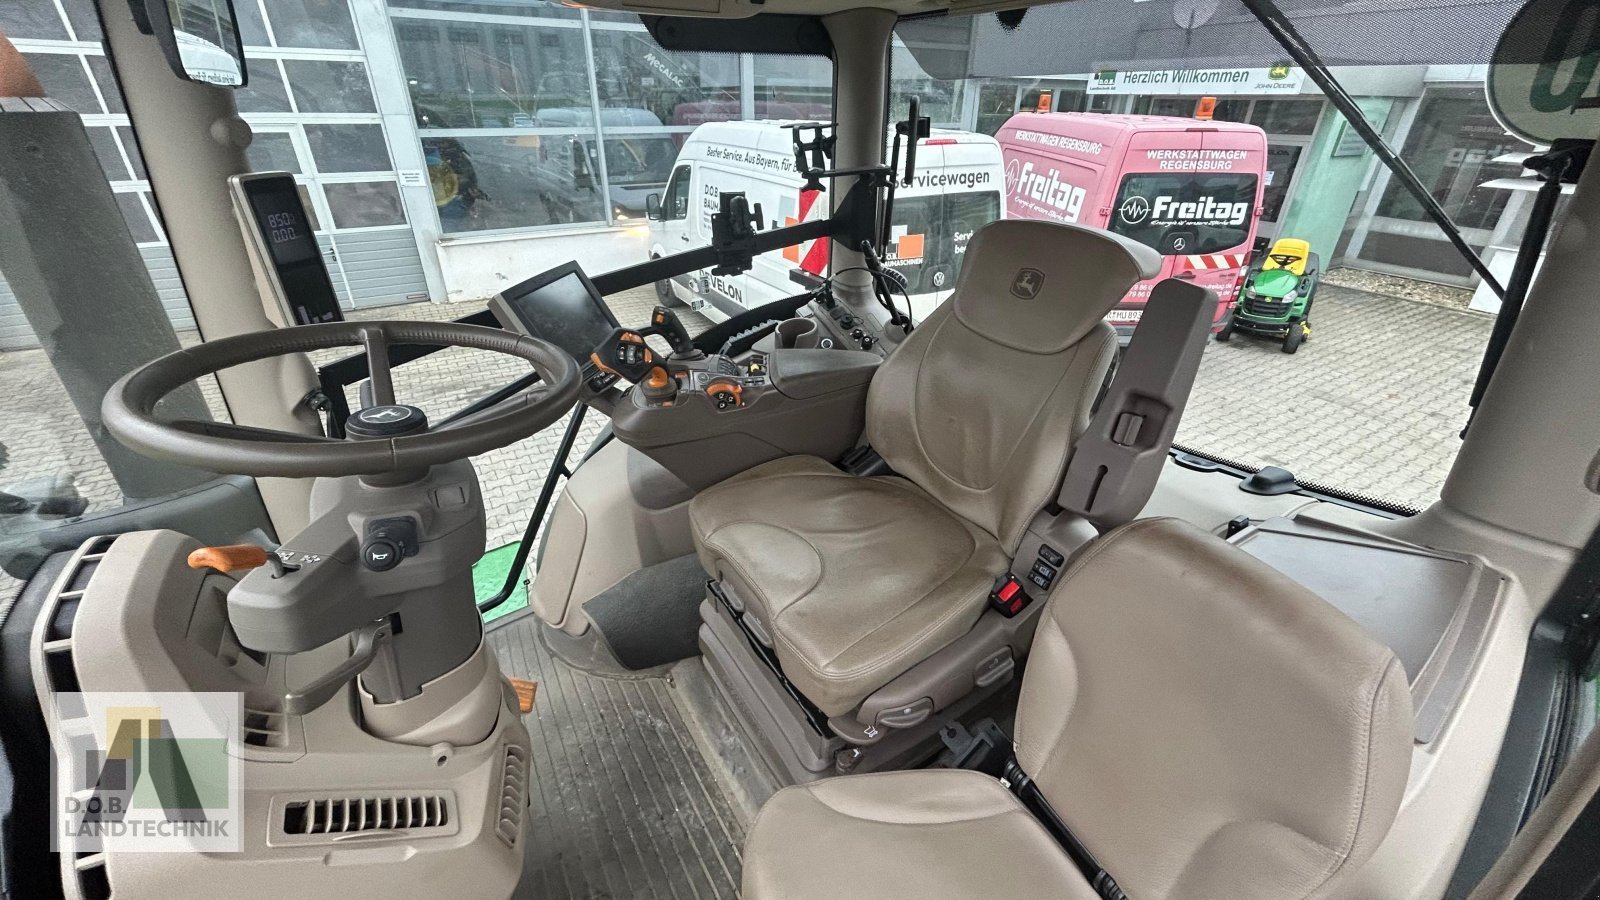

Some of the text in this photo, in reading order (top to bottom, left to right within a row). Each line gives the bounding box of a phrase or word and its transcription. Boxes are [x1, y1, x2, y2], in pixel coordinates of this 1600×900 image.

[1123, 69, 1249, 84] Herzlich Willkommen
[1059, 136, 1102, 154] REGENSBURG
[706, 146, 722, 156] Bester
[722, 148, 743, 162] Service.
[743, 152, 755, 164] Aus
[756, 154, 780, 170] Bayern,
[781, 157, 792, 172] für
[1147, 150, 1247, 159] WERKSTATTWAGEN
[1160, 161, 1232, 170] REGENSBURG
[1017, 161, 1087, 223] Freitag
[704, 198, 719, 211] BAUM
[1152, 195, 1249, 225] Freitag
